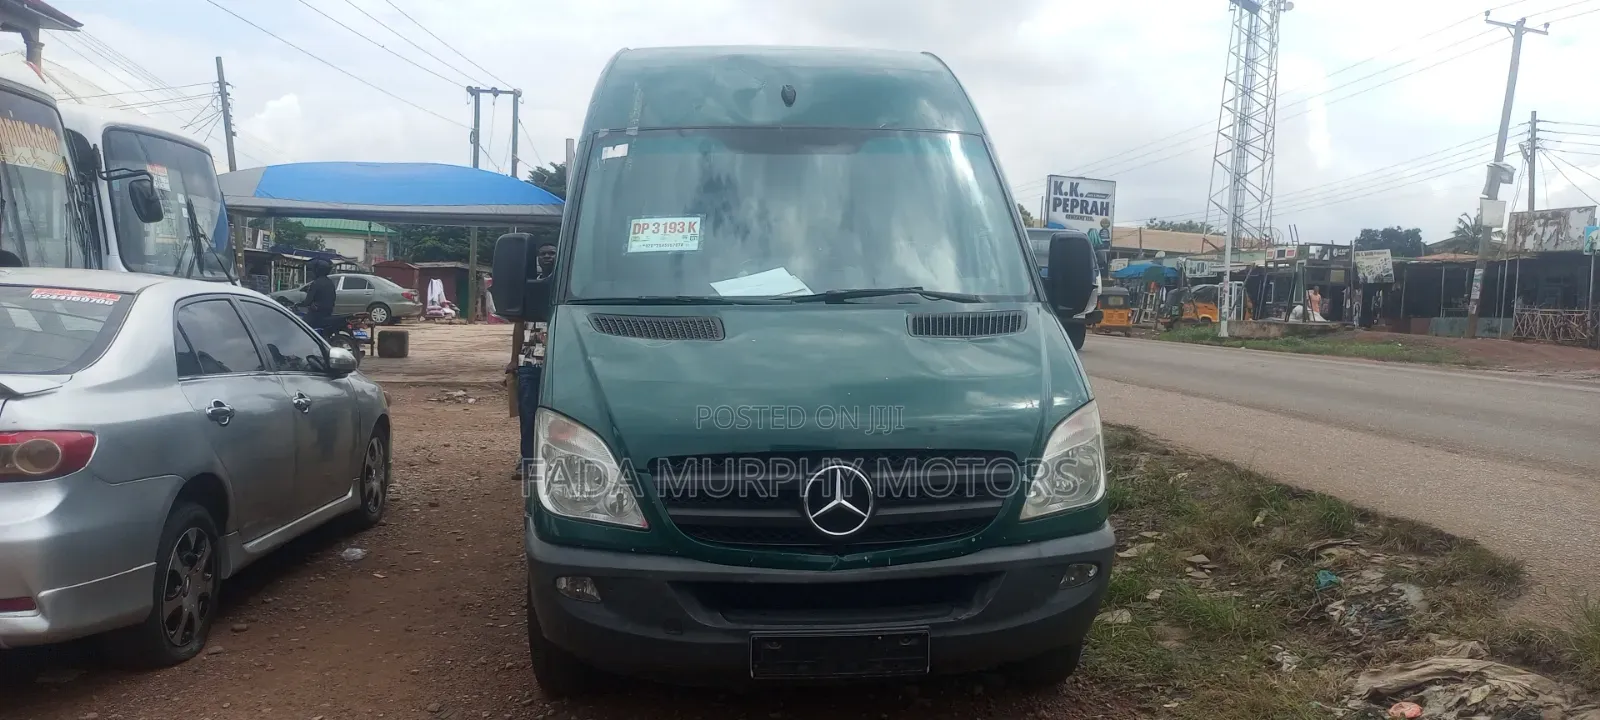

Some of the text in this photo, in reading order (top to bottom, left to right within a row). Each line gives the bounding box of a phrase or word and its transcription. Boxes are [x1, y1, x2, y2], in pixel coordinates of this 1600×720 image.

[1053, 180, 1084, 198] K.K.
[1052, 197, 1110, 217] PEPRAH
[632, 222, 649, 235] DP
[687, 221, 698, 234] K
